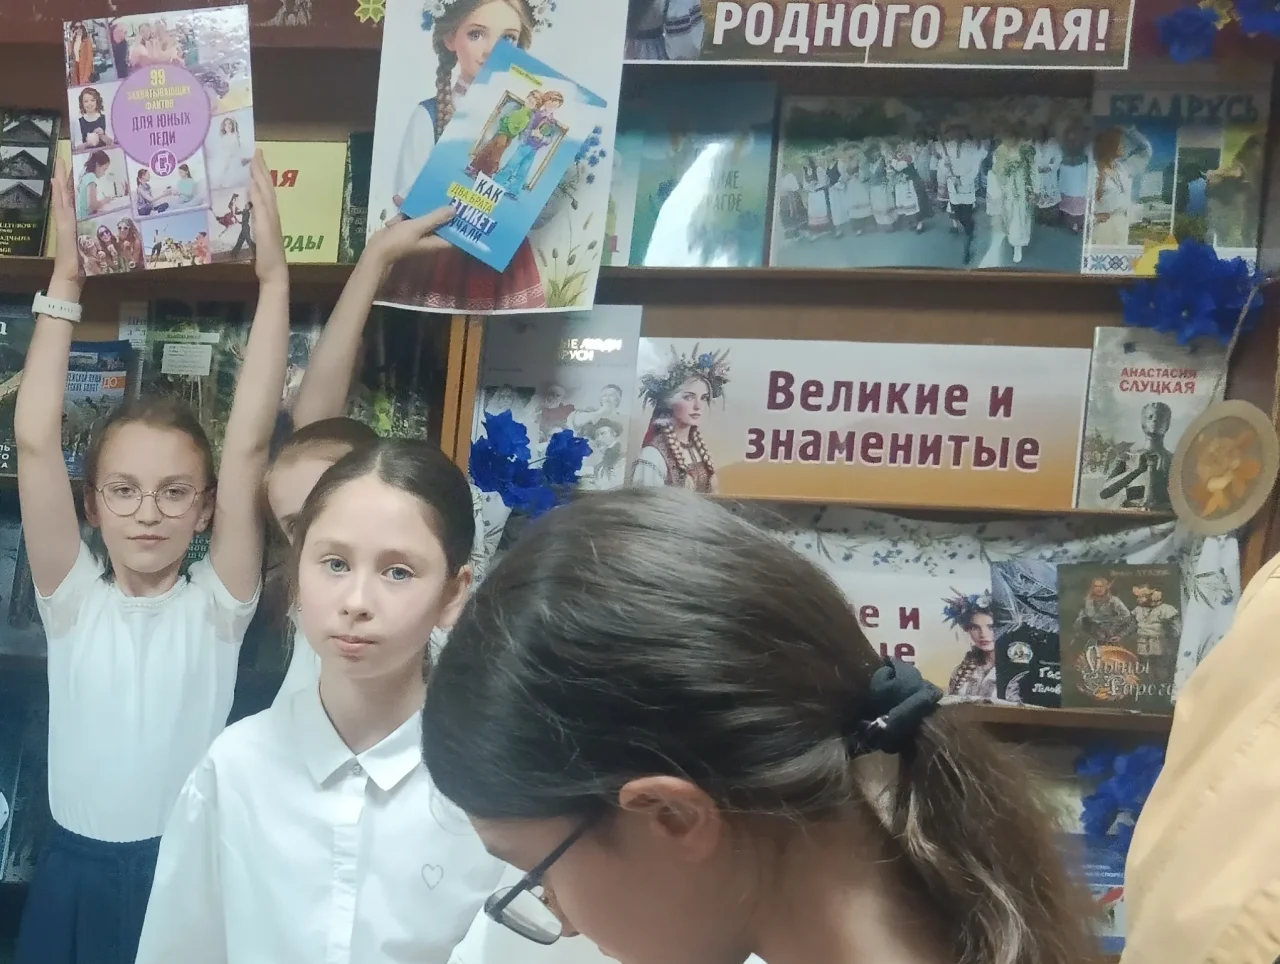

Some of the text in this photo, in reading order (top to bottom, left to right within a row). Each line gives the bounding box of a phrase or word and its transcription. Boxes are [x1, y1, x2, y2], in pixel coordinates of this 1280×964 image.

[713, 1, 1110, 54] РОДНОГО КРАЯ!
[150, 69, 165, 86] 99
[132, 112, 191, 132] ДЛЯ ЮНЫХ
[149, 131, 176, 146] ЛЕДИ
[450, 184, 494, 213] ДВА БРАТА
[475, 179, 503, 203] КАК
[1121, 367, 1197, 378] АНАСТАСИЯ
[103, 377, 117, 389] ДО
[1120, 380, 1195, 395] СЛУЦКАЯ
[766, 369, 1014, 418] Великие и
[744, 427, 1040, 472] знаменитые
